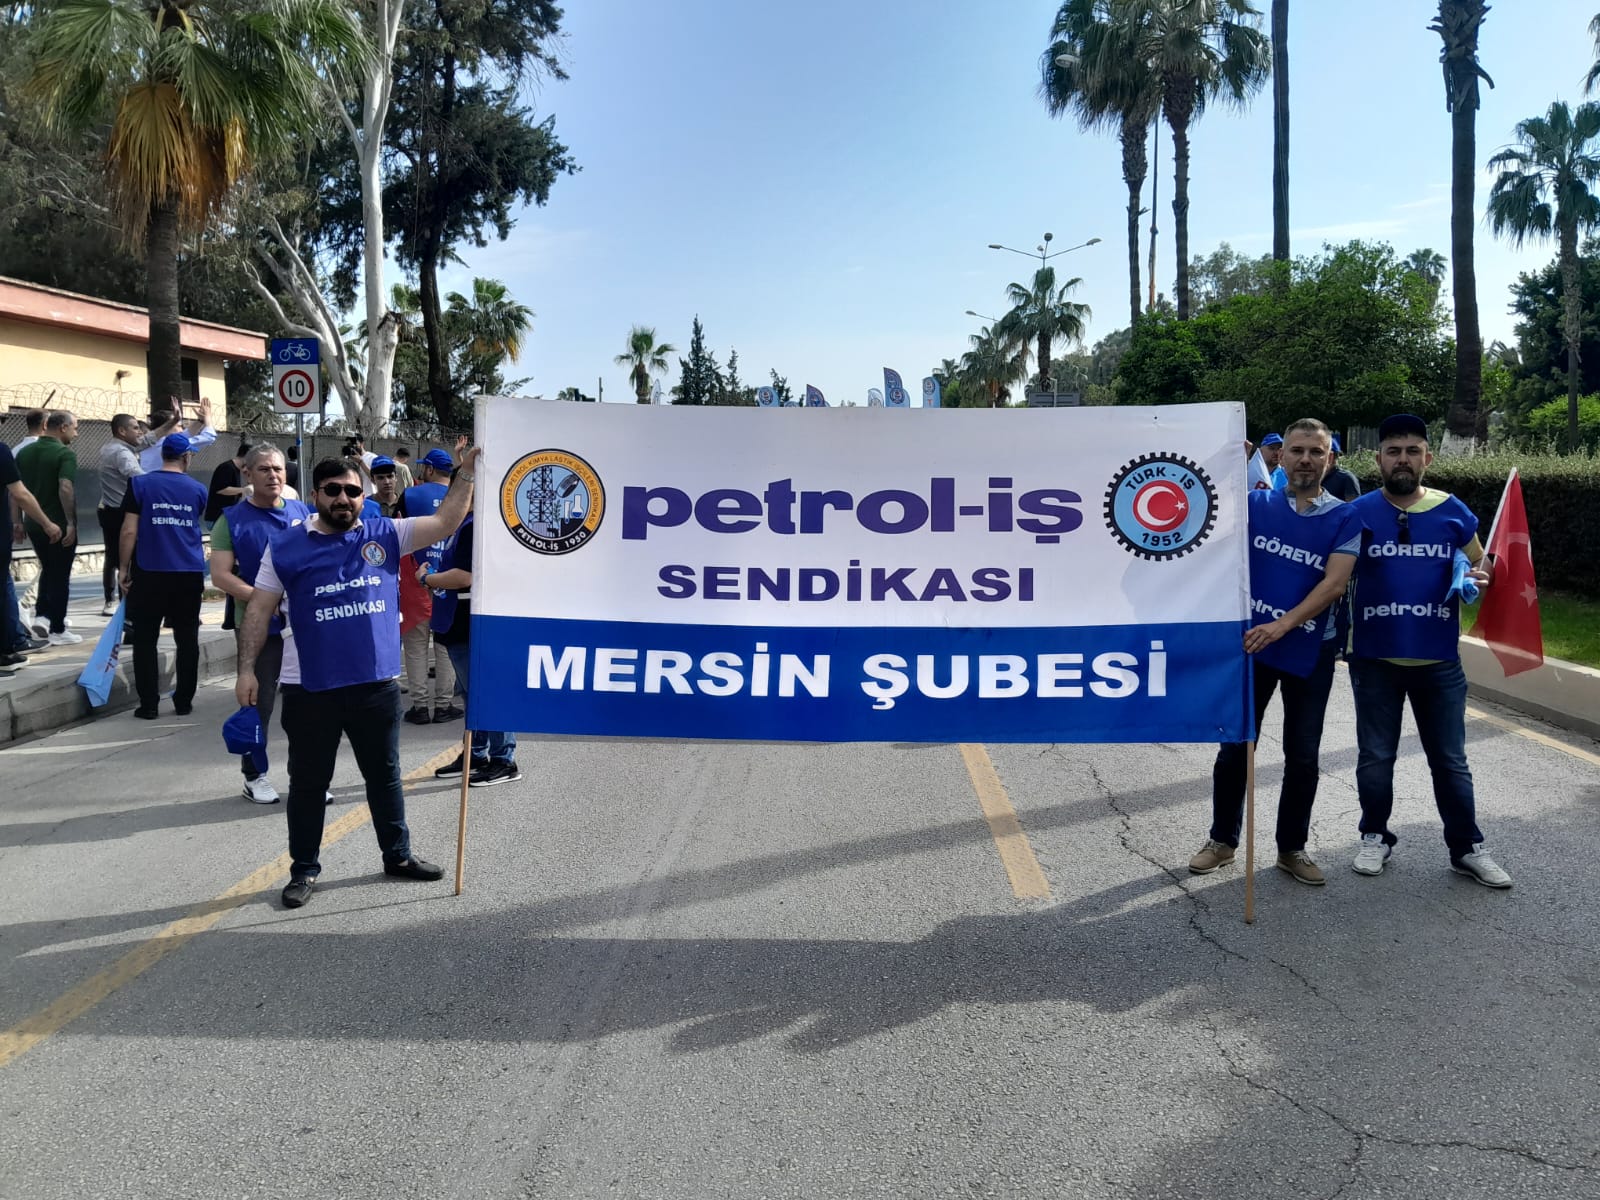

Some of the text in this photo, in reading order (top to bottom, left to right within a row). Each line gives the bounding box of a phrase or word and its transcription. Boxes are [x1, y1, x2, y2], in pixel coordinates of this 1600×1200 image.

[288, 380, 304, 397] 10
[508, 464, 528, 487] PETROL
[1125, 466, 1166, 490] TÜRK
[622, 477, 1083, 544] petrol-iş
[565, 531, 586, 548] 1950
[1142, 531, 1183, 547] 1952
[1367, 540, 1451, 559] GÖREVLİ
[1254, 535, 1325, 571] GÖREVL
[314, 575, 381, 597] petrol-iş
[657, 559, 1034, 602] SENDİKASI
[315, 600, 386, 622] SENDİKASI
[1363, 602, 1451, 621] petrol-iş
[526, 640, 1167, 710] MERSİN ŞUBESİ
